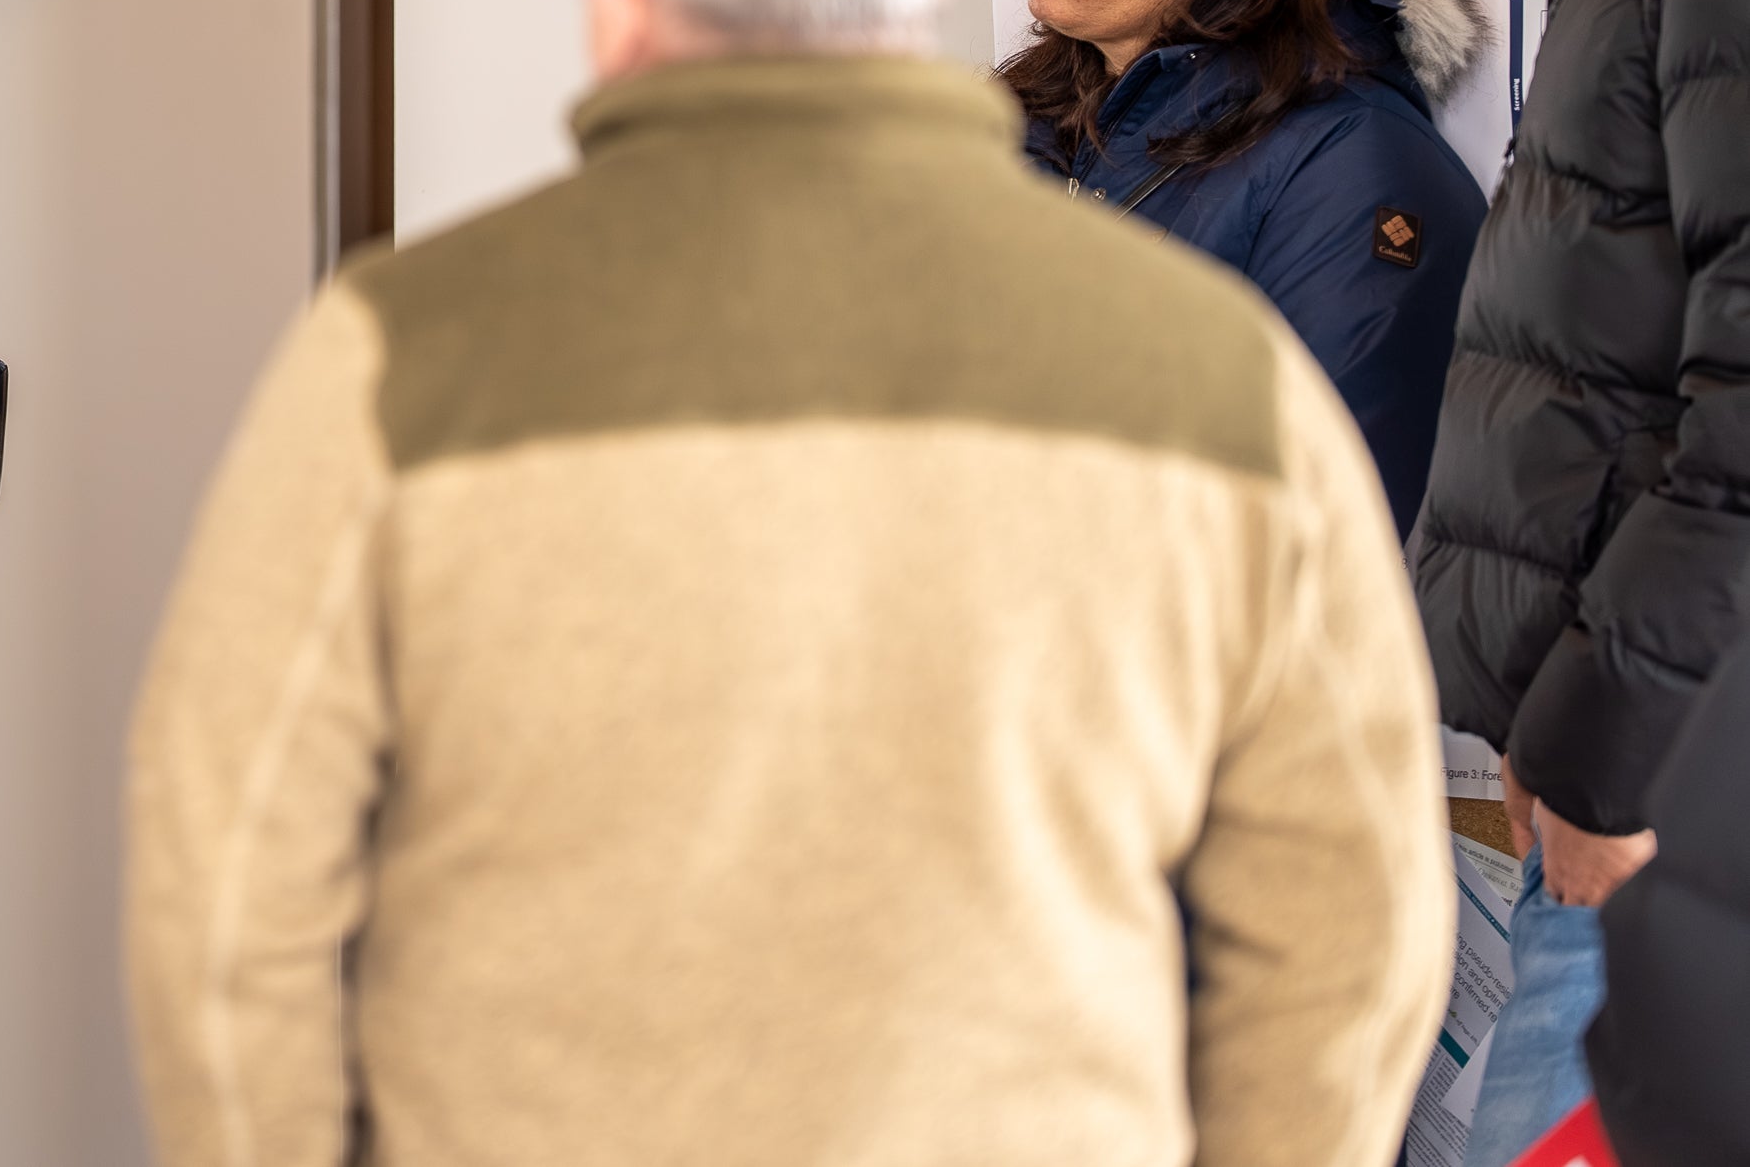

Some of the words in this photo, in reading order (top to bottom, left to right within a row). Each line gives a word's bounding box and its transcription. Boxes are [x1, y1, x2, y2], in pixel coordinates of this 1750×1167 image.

[1512, 78, 1521, 111] Screening
[1481, 770, 1503, 781] Fore
[1468, 969, 1484, 986] and
[1482, 985, 1504, 1010] optim
